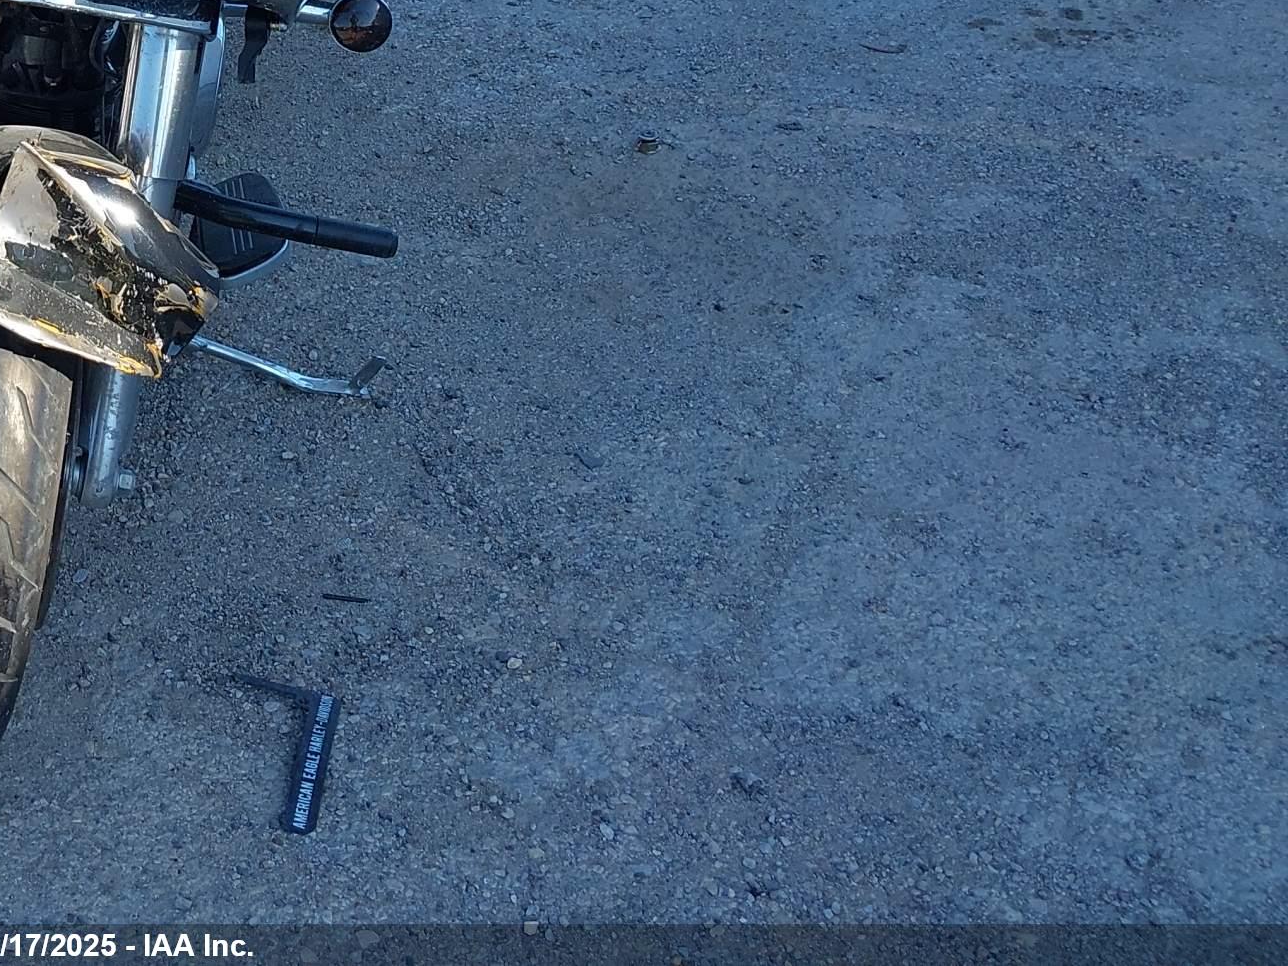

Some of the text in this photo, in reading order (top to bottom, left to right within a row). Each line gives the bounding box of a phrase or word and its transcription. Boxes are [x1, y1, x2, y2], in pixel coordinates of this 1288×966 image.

[293, 695, 335, 829] AMERICAN EAGLE HARLEY-DAVIDSON
